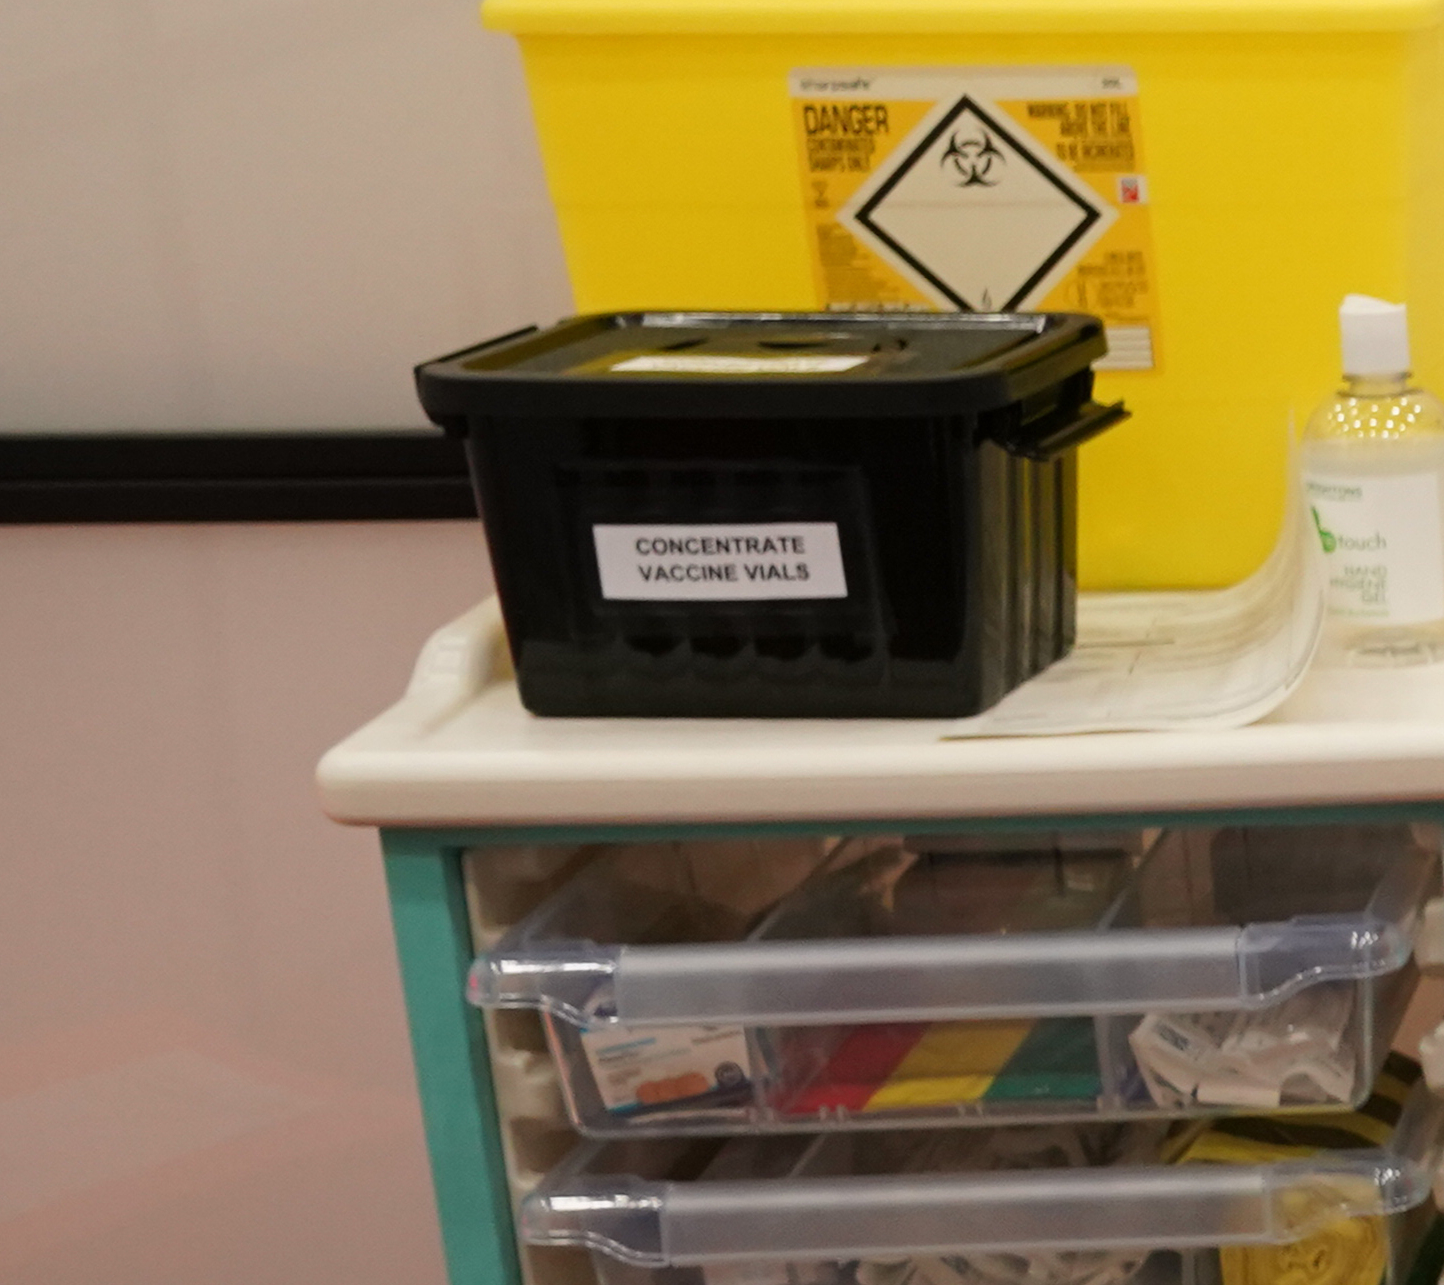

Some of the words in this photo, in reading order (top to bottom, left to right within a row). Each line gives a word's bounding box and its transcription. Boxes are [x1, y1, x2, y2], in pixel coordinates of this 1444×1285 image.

[803, 104, 890, 136] DANGER
[635, 536, 806, 556] CONCENTRATE
[639, 564, 738, 582] VACCINE
[744, 563, 810, 581] VIALS
